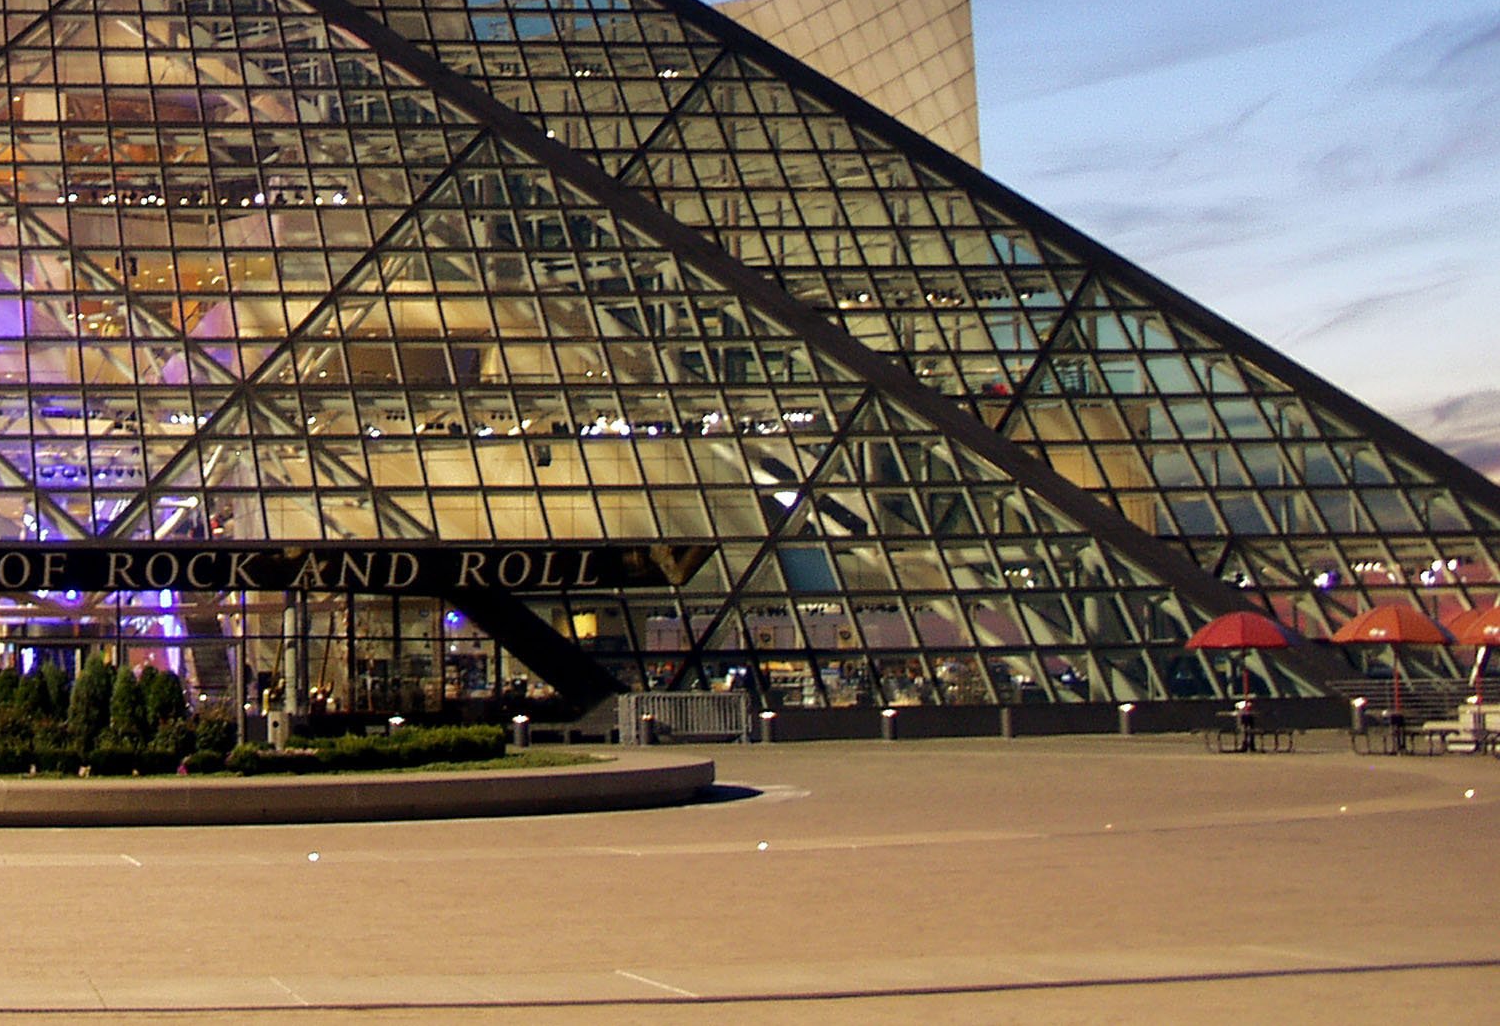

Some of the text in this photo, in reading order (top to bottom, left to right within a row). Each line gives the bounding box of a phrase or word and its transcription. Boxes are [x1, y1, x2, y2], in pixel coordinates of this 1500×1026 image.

[105, 551, 261, 588] ROCK
[290, 550, 419, 588] AND
[456, 550, 599, 587] ROLL
